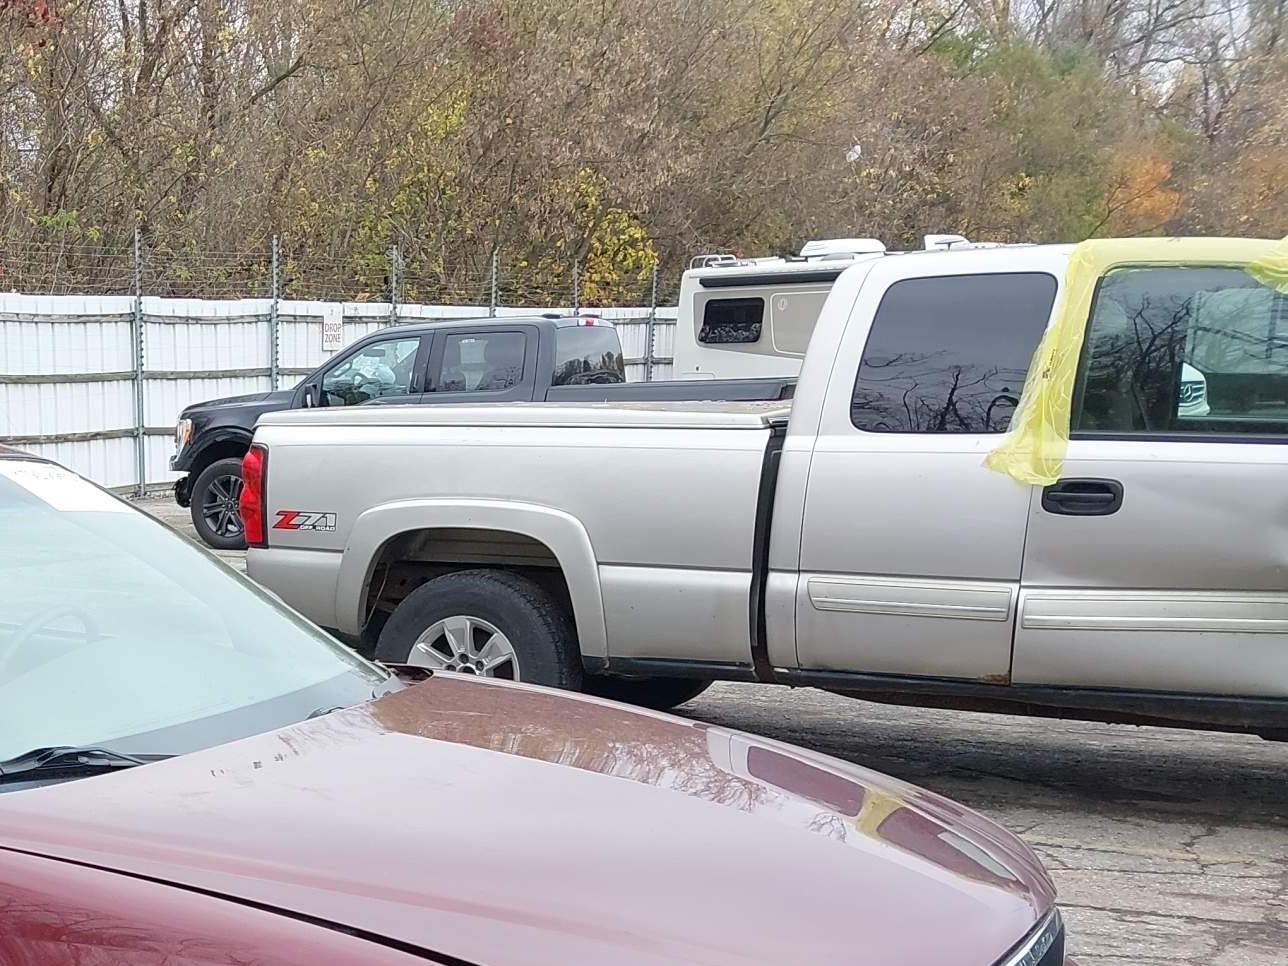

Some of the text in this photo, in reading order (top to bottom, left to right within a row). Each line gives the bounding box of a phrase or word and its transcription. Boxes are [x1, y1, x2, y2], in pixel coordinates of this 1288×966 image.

[324, 322, 342, 333] DROP
[324, 333, 342, 343] ZONE
[272, 510, 337, 530] Z71
